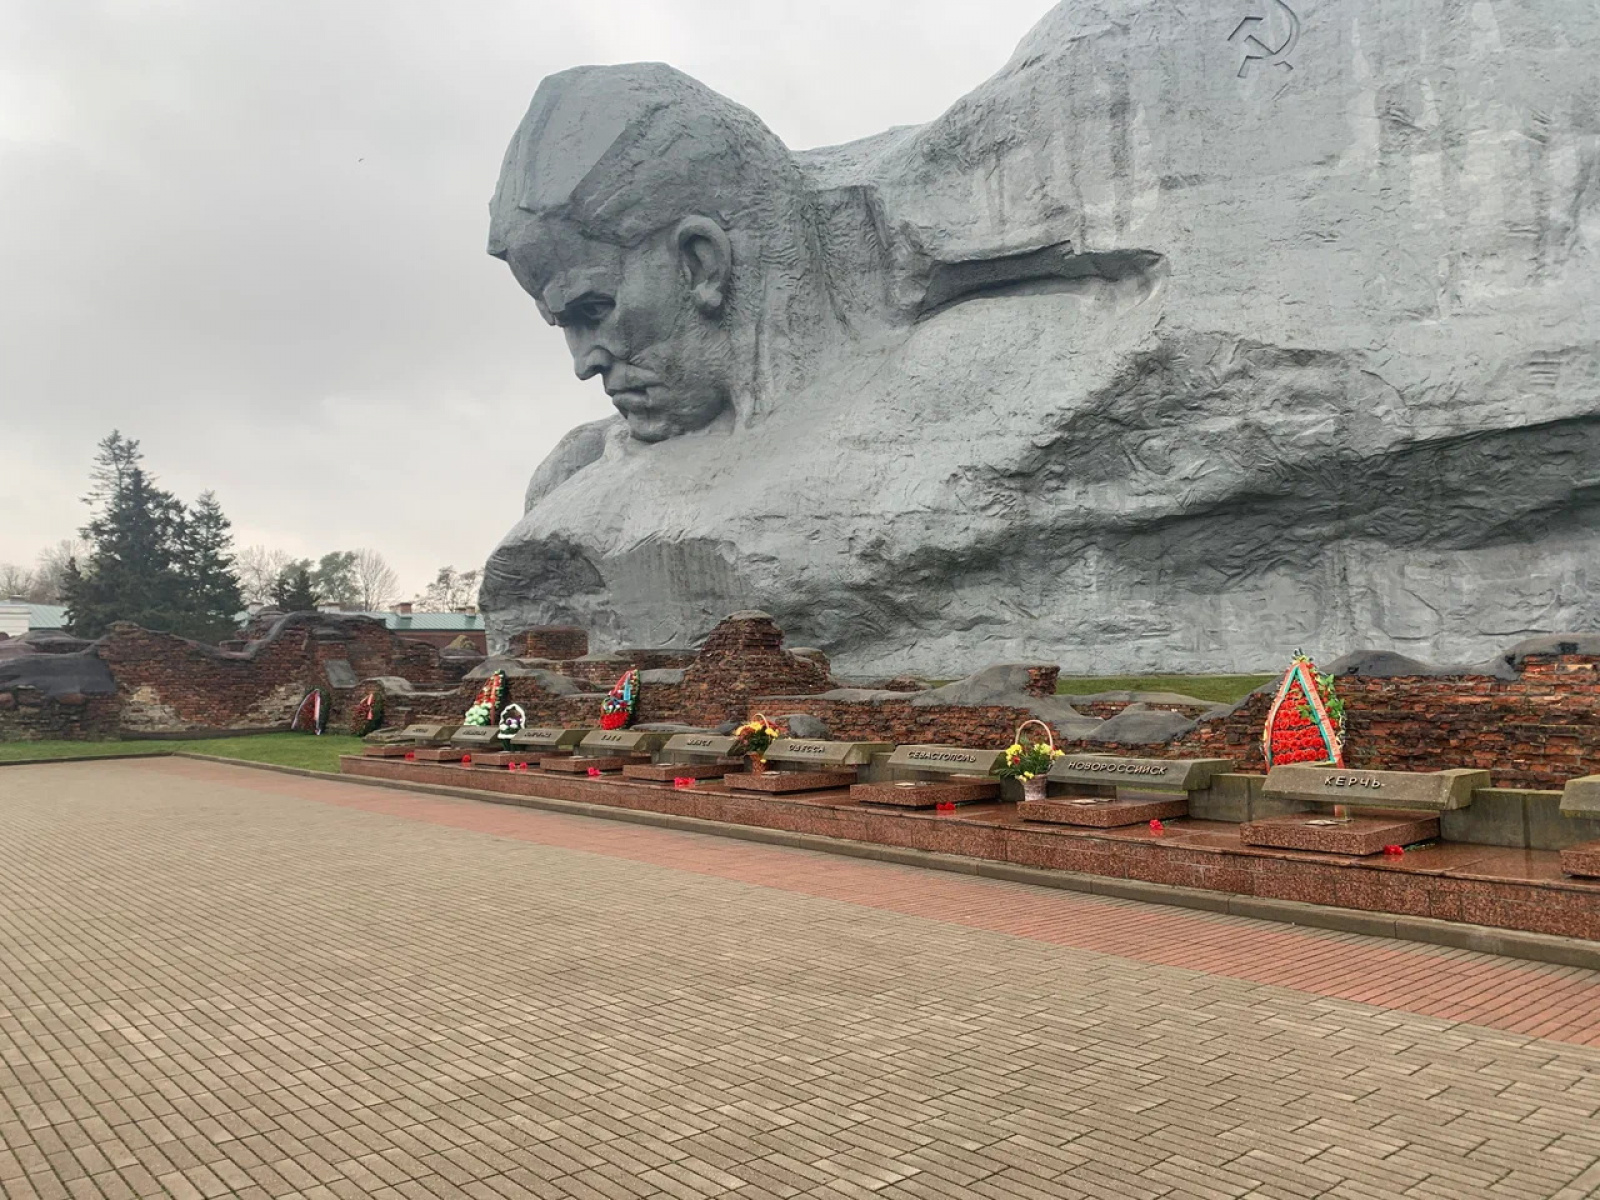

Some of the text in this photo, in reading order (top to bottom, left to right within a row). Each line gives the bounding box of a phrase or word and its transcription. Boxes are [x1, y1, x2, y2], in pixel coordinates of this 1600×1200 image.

[907, 750, 977, 763] СЕВАСТОПОЛЬ
[1068, 760, 1168, 776] НОВОРОССИЙСК
[1324, 775, 1382, 789] КЕРЧЬ
